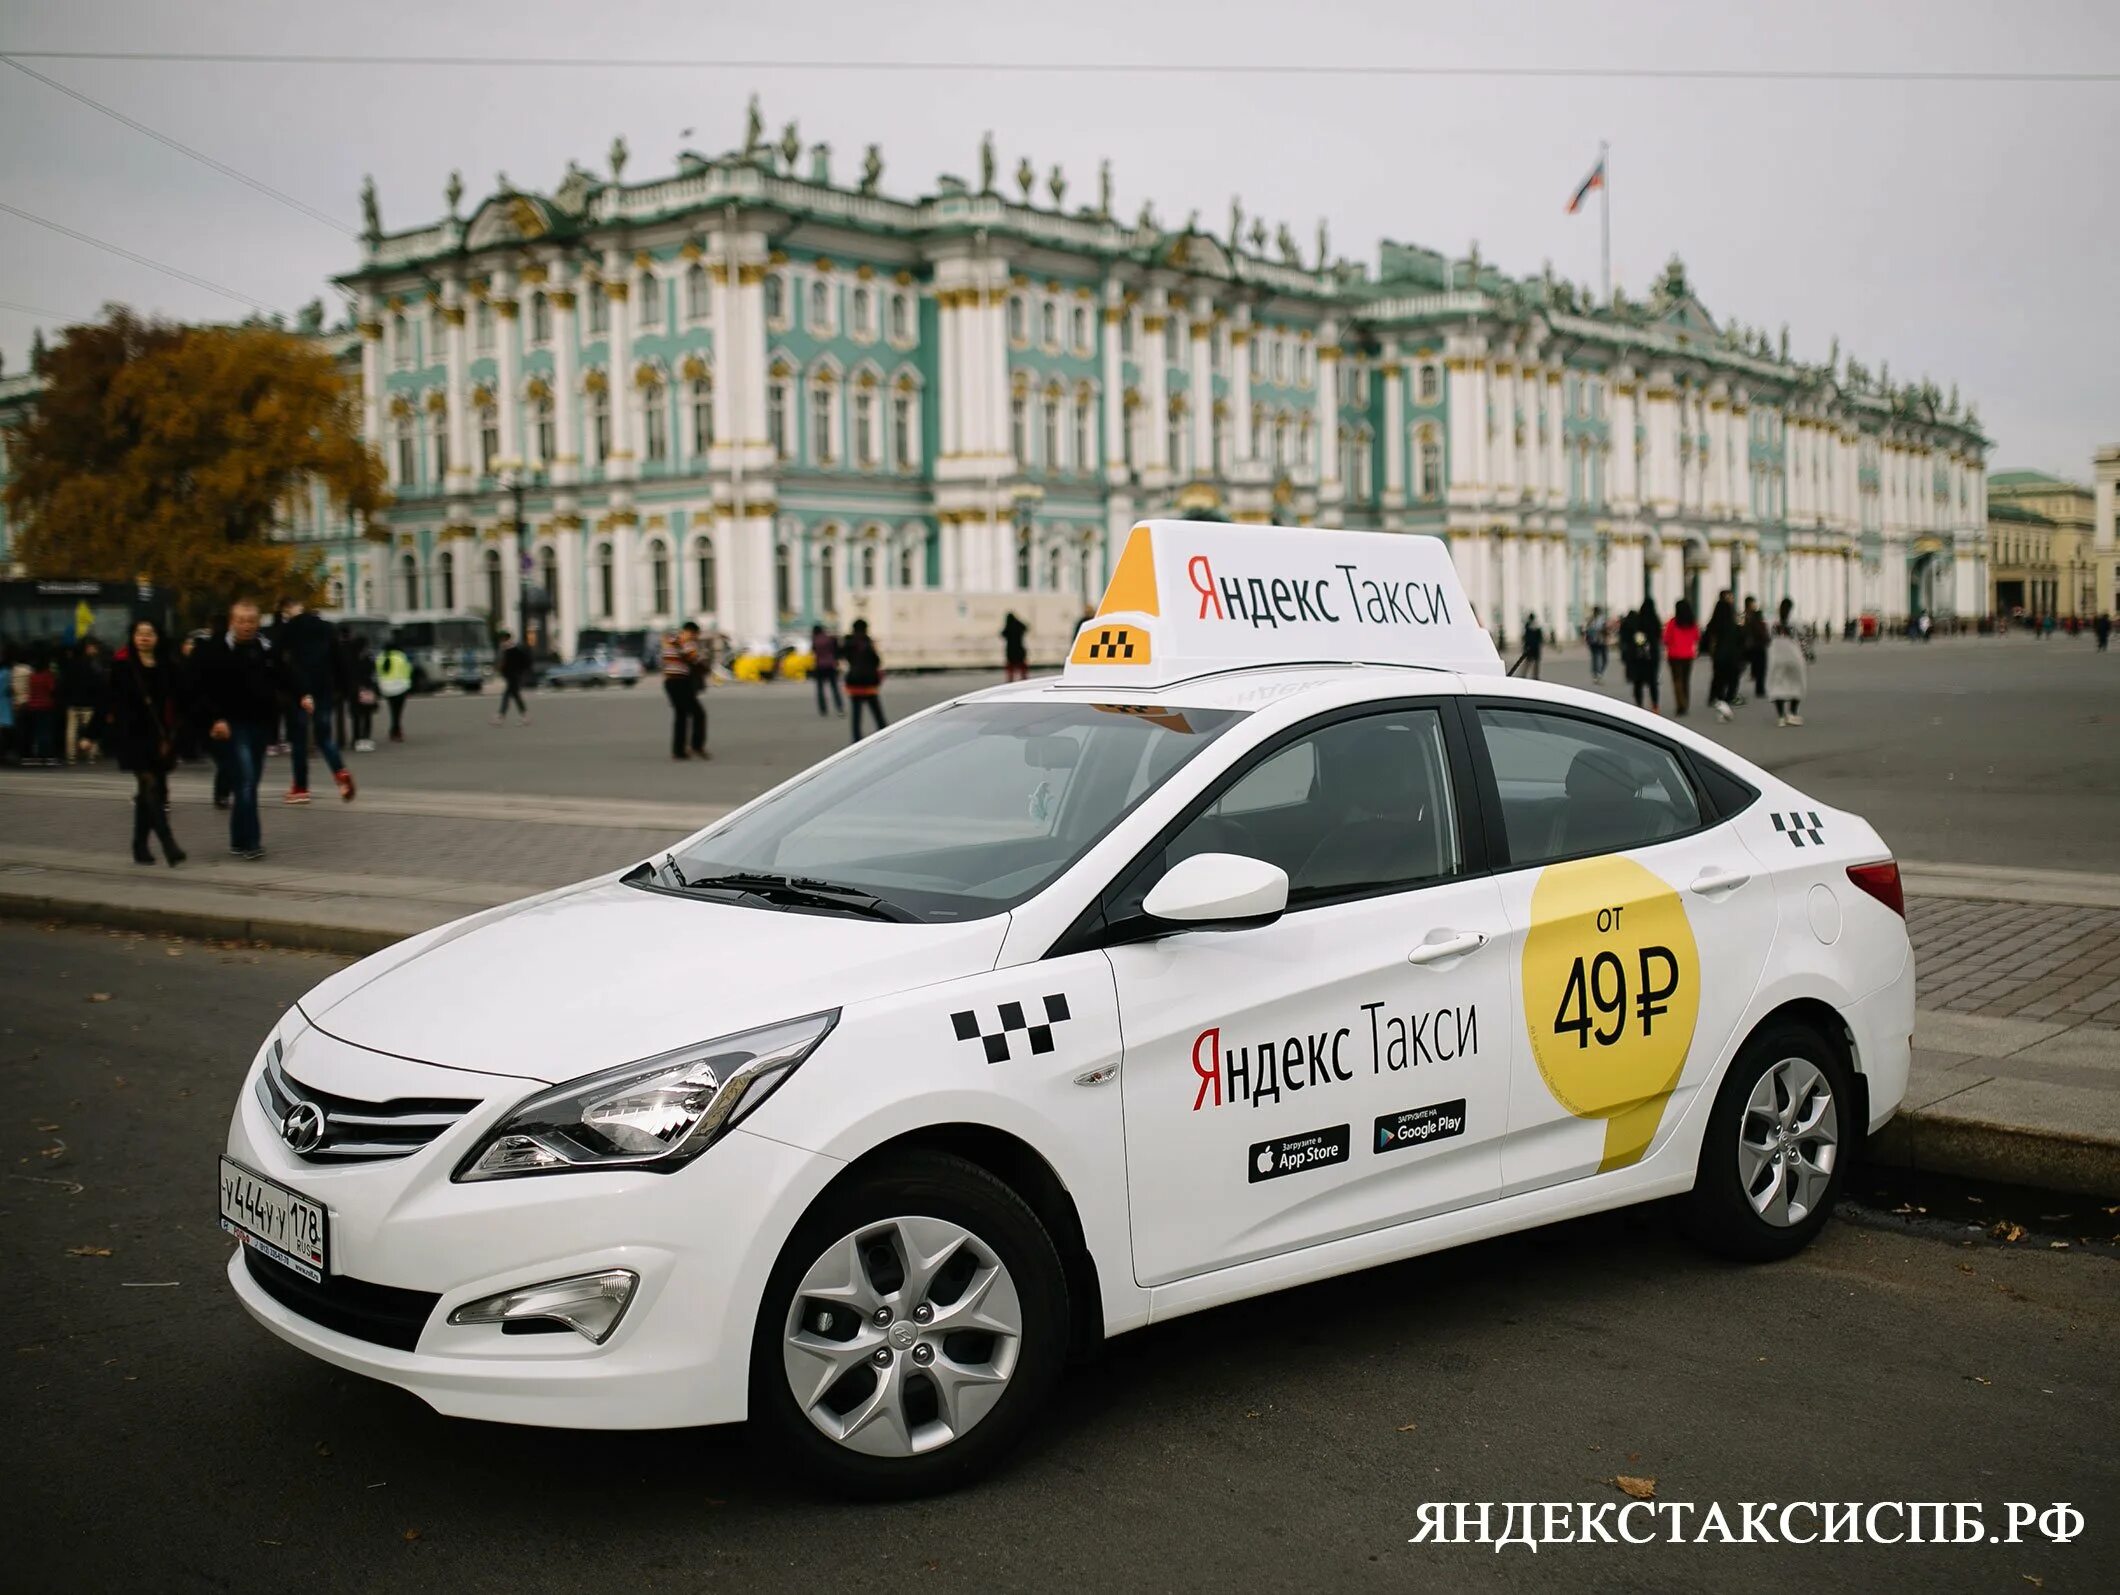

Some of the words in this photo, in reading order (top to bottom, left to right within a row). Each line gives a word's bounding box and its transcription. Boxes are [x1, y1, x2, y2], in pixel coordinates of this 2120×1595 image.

[1188, 555, 1340, 629] Яндекс
[1335, 564, 1453, 626] Такси
[1191, 1027, 1354, 1112] Яндекс
[1360, 1001, 1480, 1075] Такси
[1397, 1109, 1429, 1124] ЗАГРУЗИТЕ
[1429, 1108, 1438, 1118] НА
[1397, 1120, 1437, 1140] Google
[1438, 1115, 1462, 1132] Play
[1279, 1152, 1306, 1170] App
[1306, 1144, 1339, 1162] Store
[1282, 1137, 1317, 1152] Загрузите
[290, 1201, 319, 1245] 178
[296, 1239, 312, 1257] RUS
